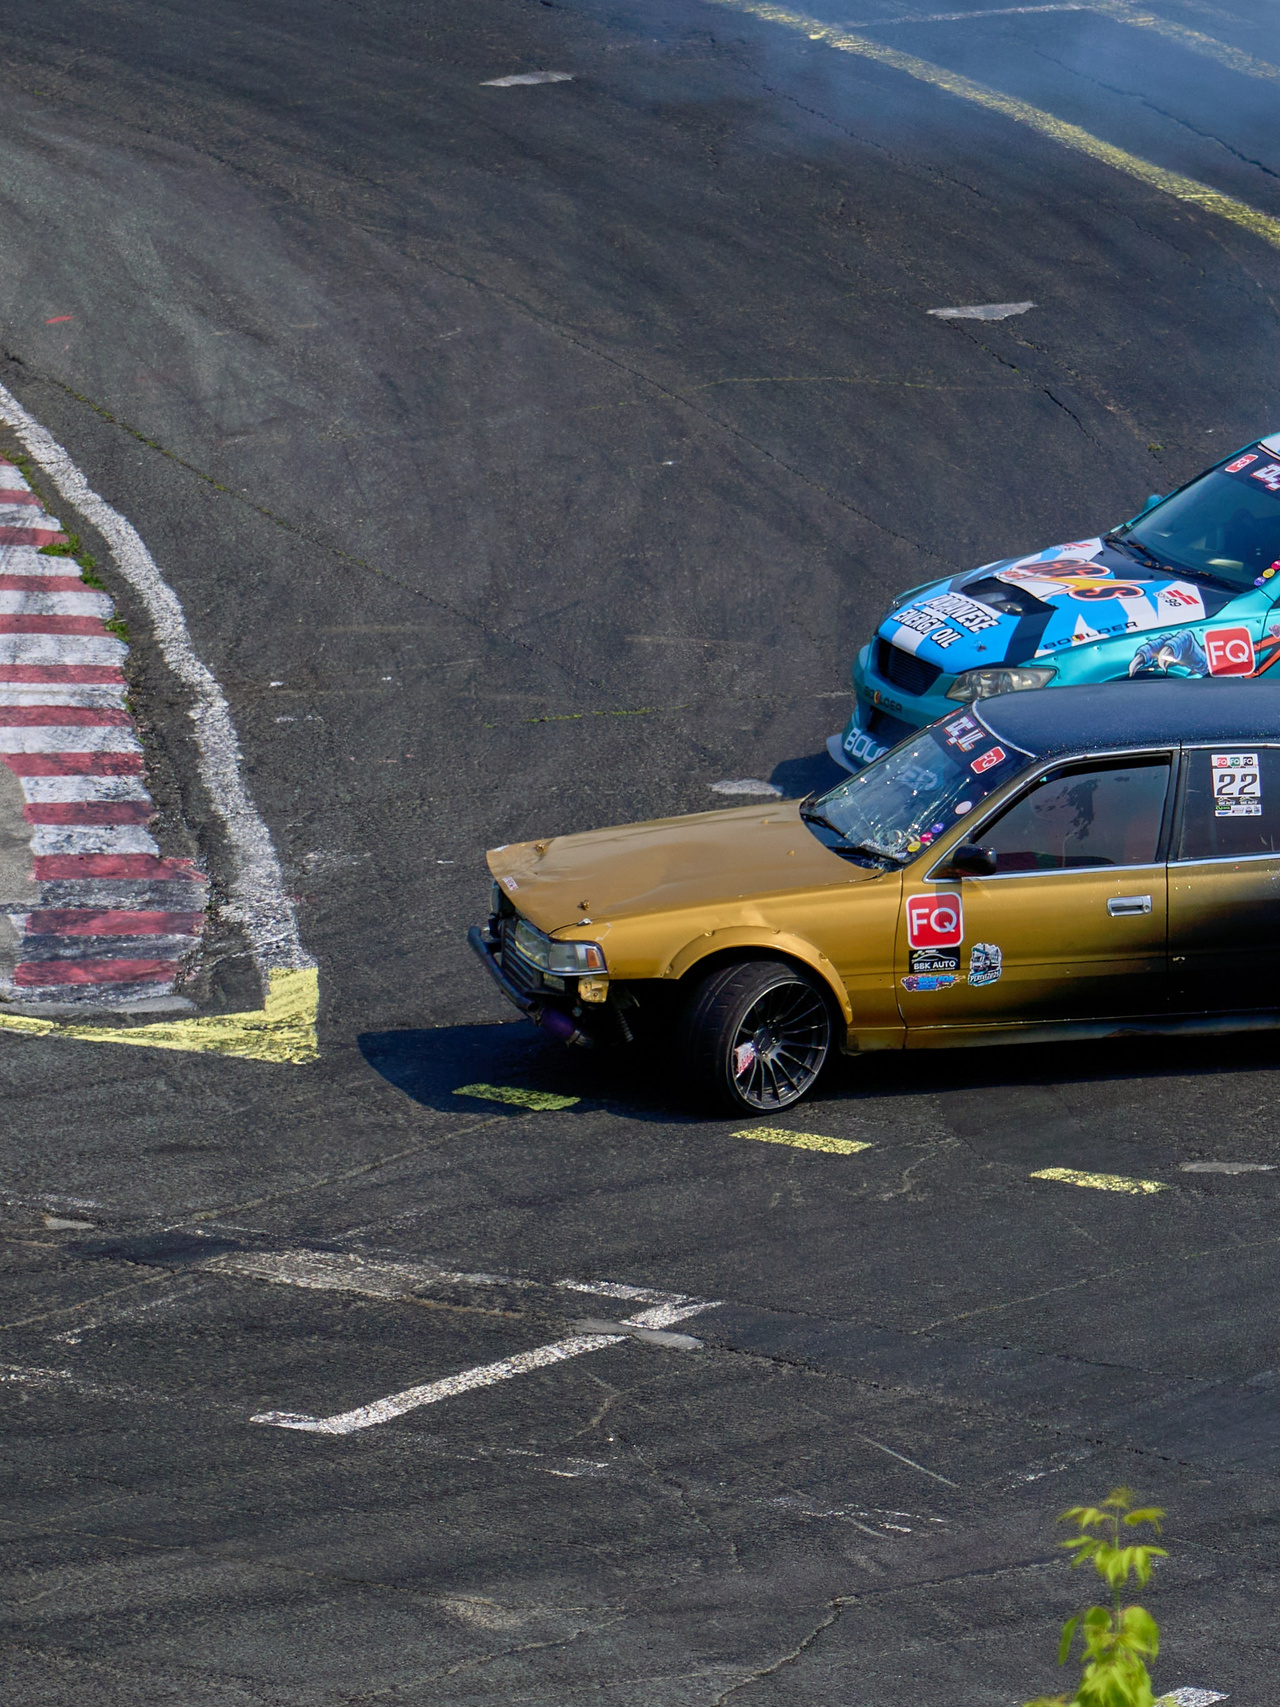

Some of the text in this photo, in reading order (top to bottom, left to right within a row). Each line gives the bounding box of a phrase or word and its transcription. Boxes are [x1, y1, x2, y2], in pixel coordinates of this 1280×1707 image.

[892, 608, 948, 635] ENERGY
[930, 627, 964, 649] OIL
[1209, 639, 1249, 665] FQ
[1217, 773, 1257, 796] 22
[911, 907, 957, 936] FQ
[913, 960, 956, 970] BBK AUTO
